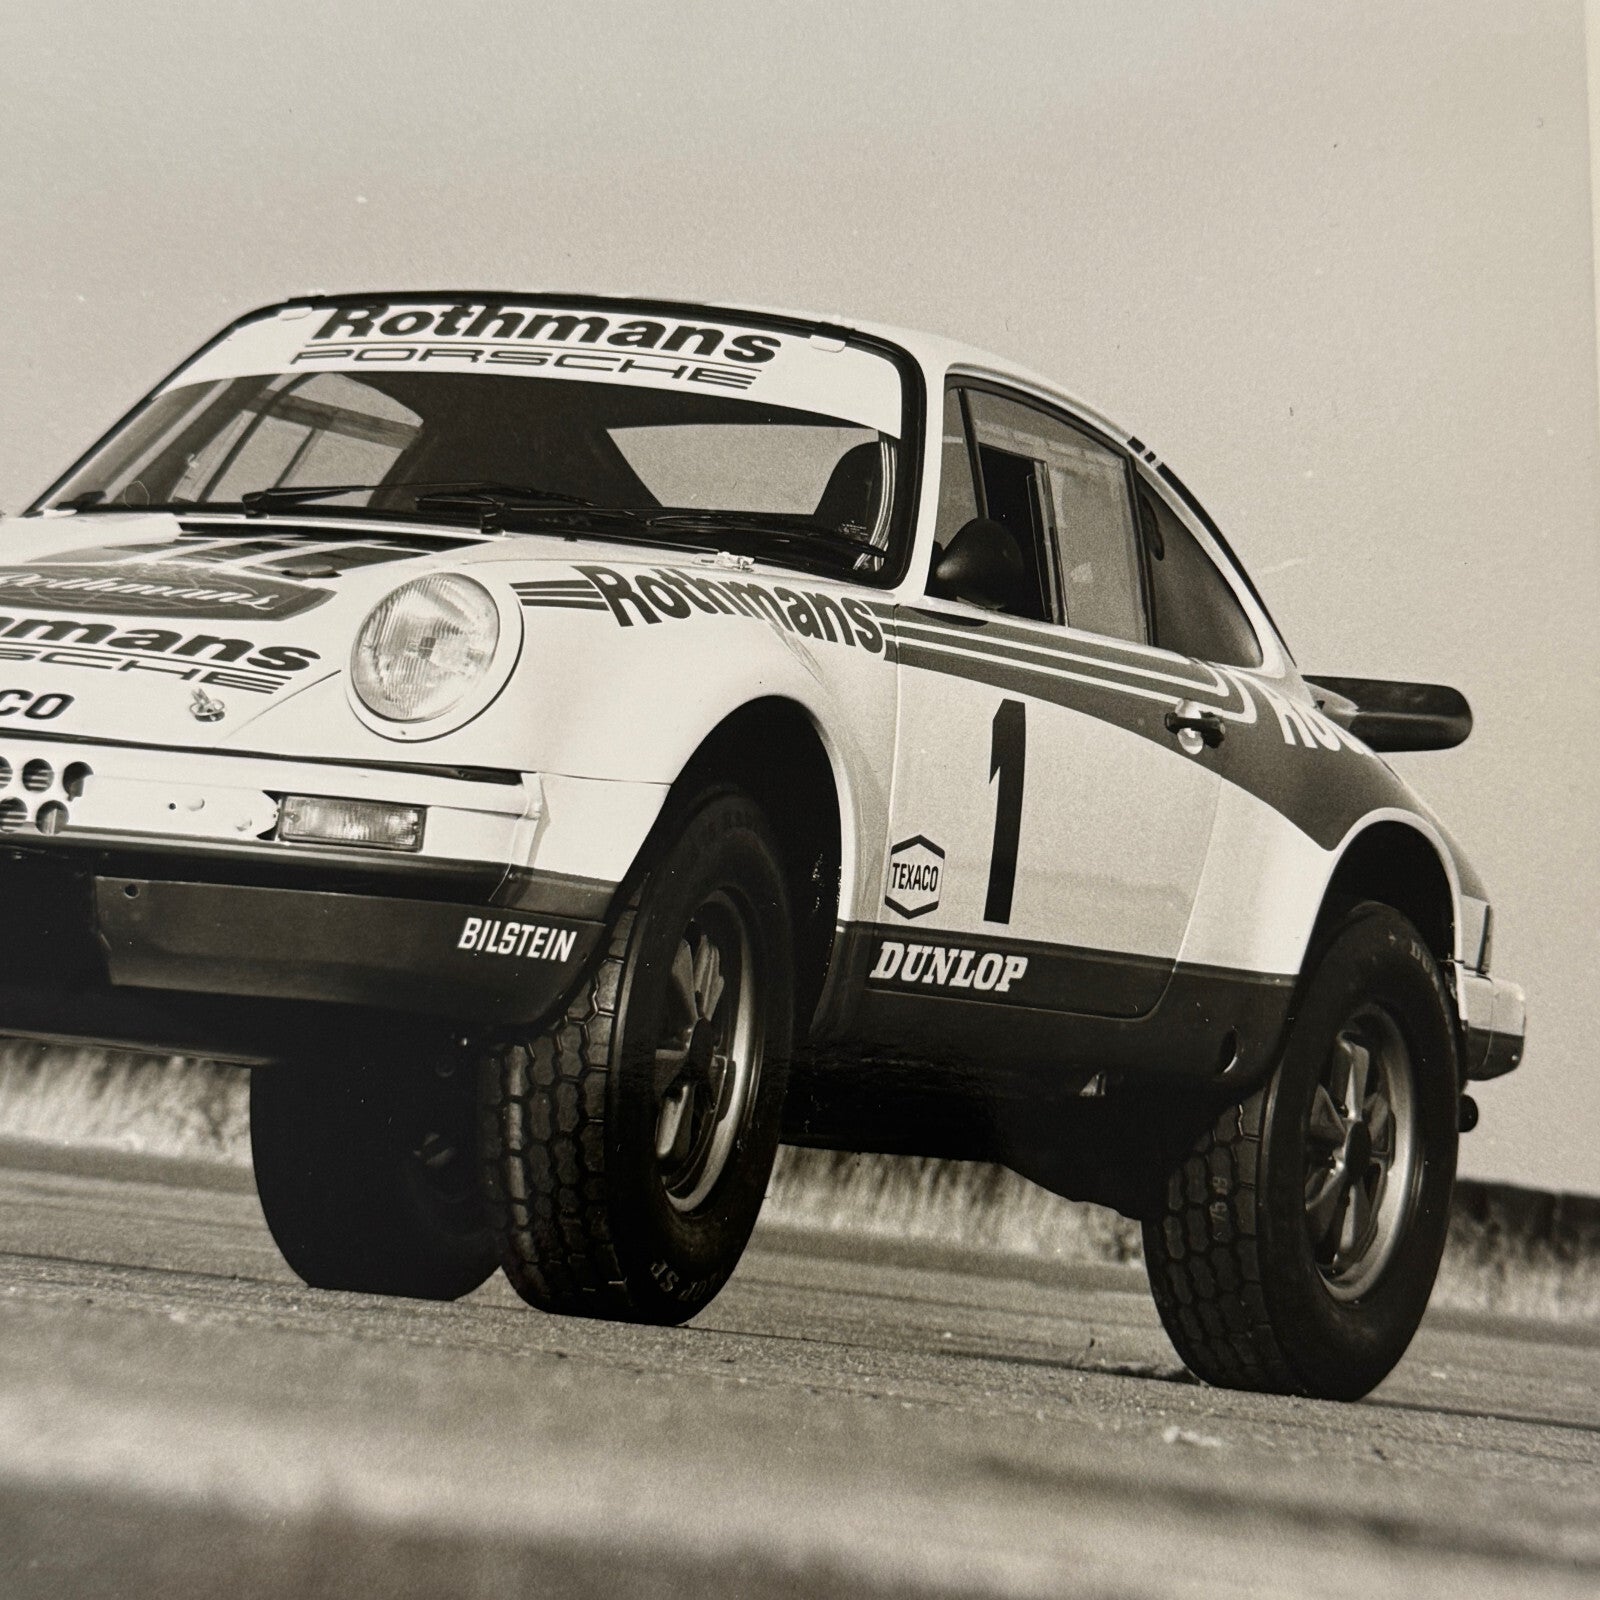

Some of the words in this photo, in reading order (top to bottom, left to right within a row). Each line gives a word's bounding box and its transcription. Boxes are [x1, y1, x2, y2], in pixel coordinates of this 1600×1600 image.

[312, 304, 782, 363] Rothmans
[289, 347, 757, 390] PORSCHE
[571, 565, 883, 653] Rothmans
[0, 616, 321, 671] mans
[983, 698, 1027, 925] 1
[892, 862, 939, 892] TEXACO
[457, 917, 578, 963] BILSTEIN
[869, 941, 1028, 992] DUNLOP
